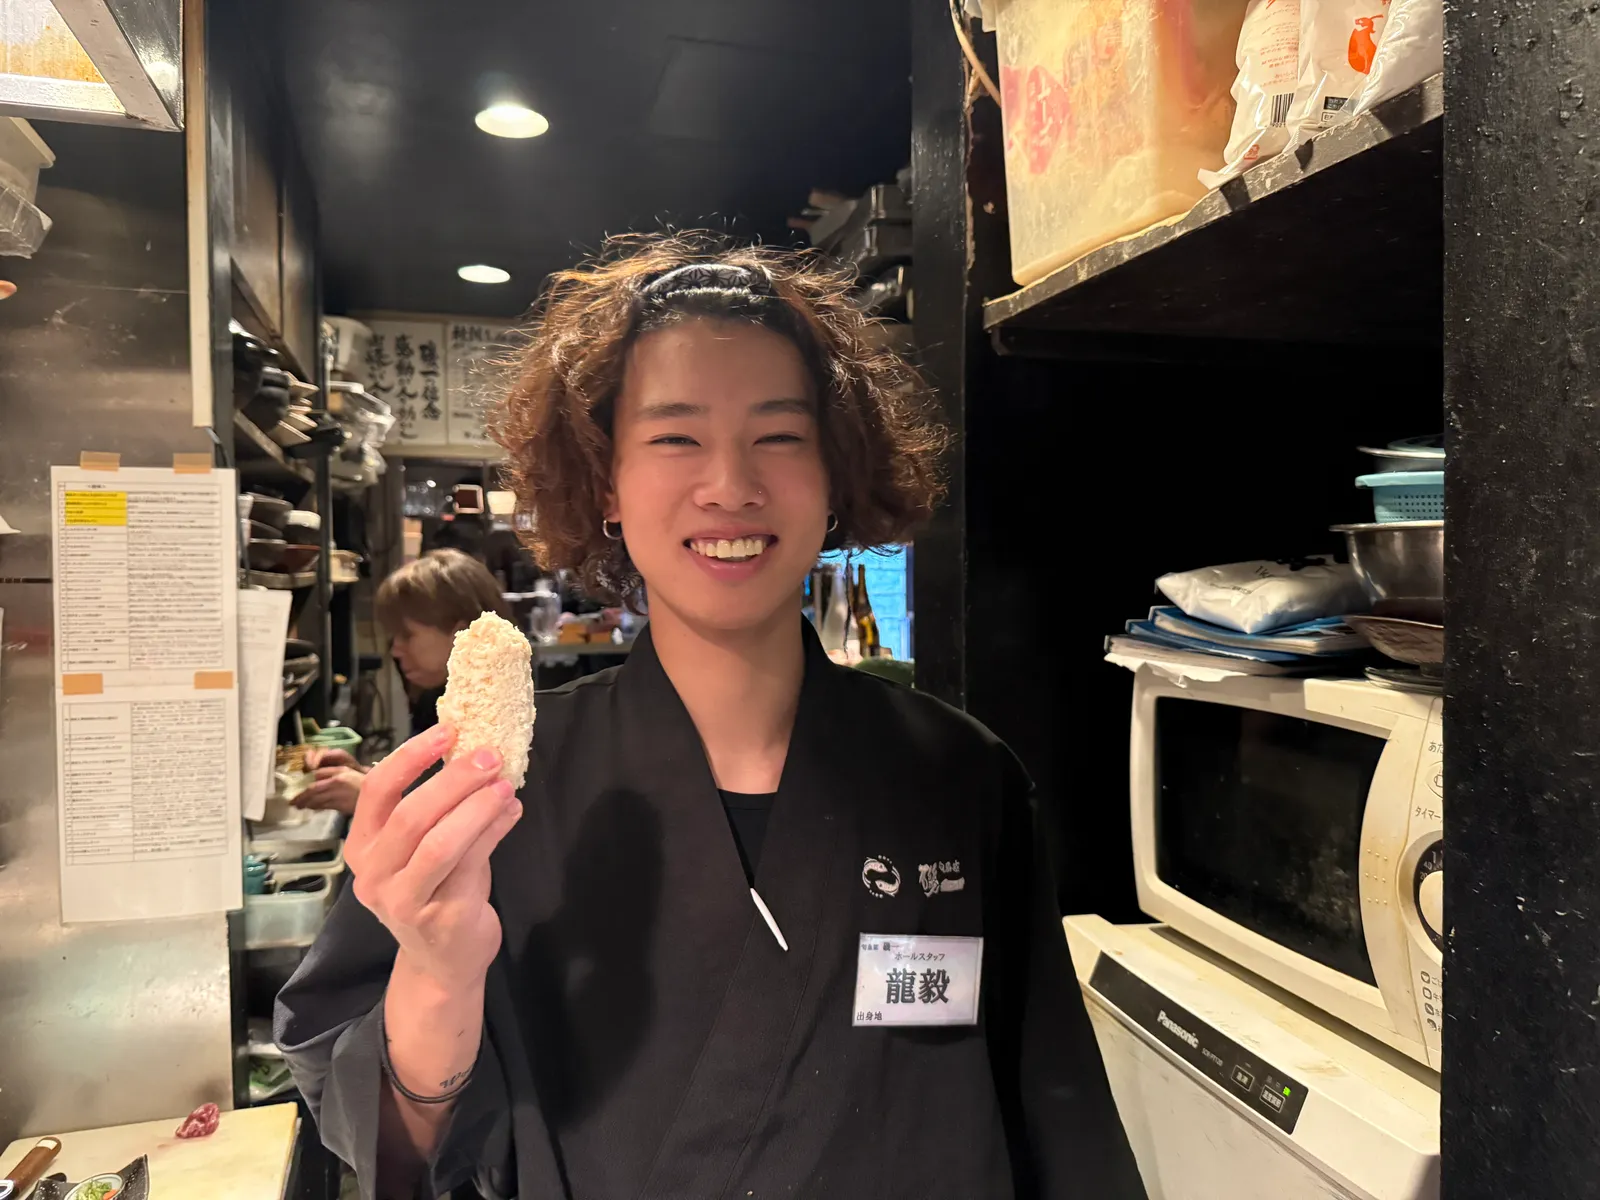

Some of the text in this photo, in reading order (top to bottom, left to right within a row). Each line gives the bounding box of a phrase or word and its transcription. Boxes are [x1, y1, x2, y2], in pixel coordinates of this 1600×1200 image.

[895, 952, 946, 961] ホールスタッフ
[886, 967, 950, 1004] 龍毅
[856, 1011, 883, 1021] 出身地
[1157, 1010, 1199, 1049] Panasonic
